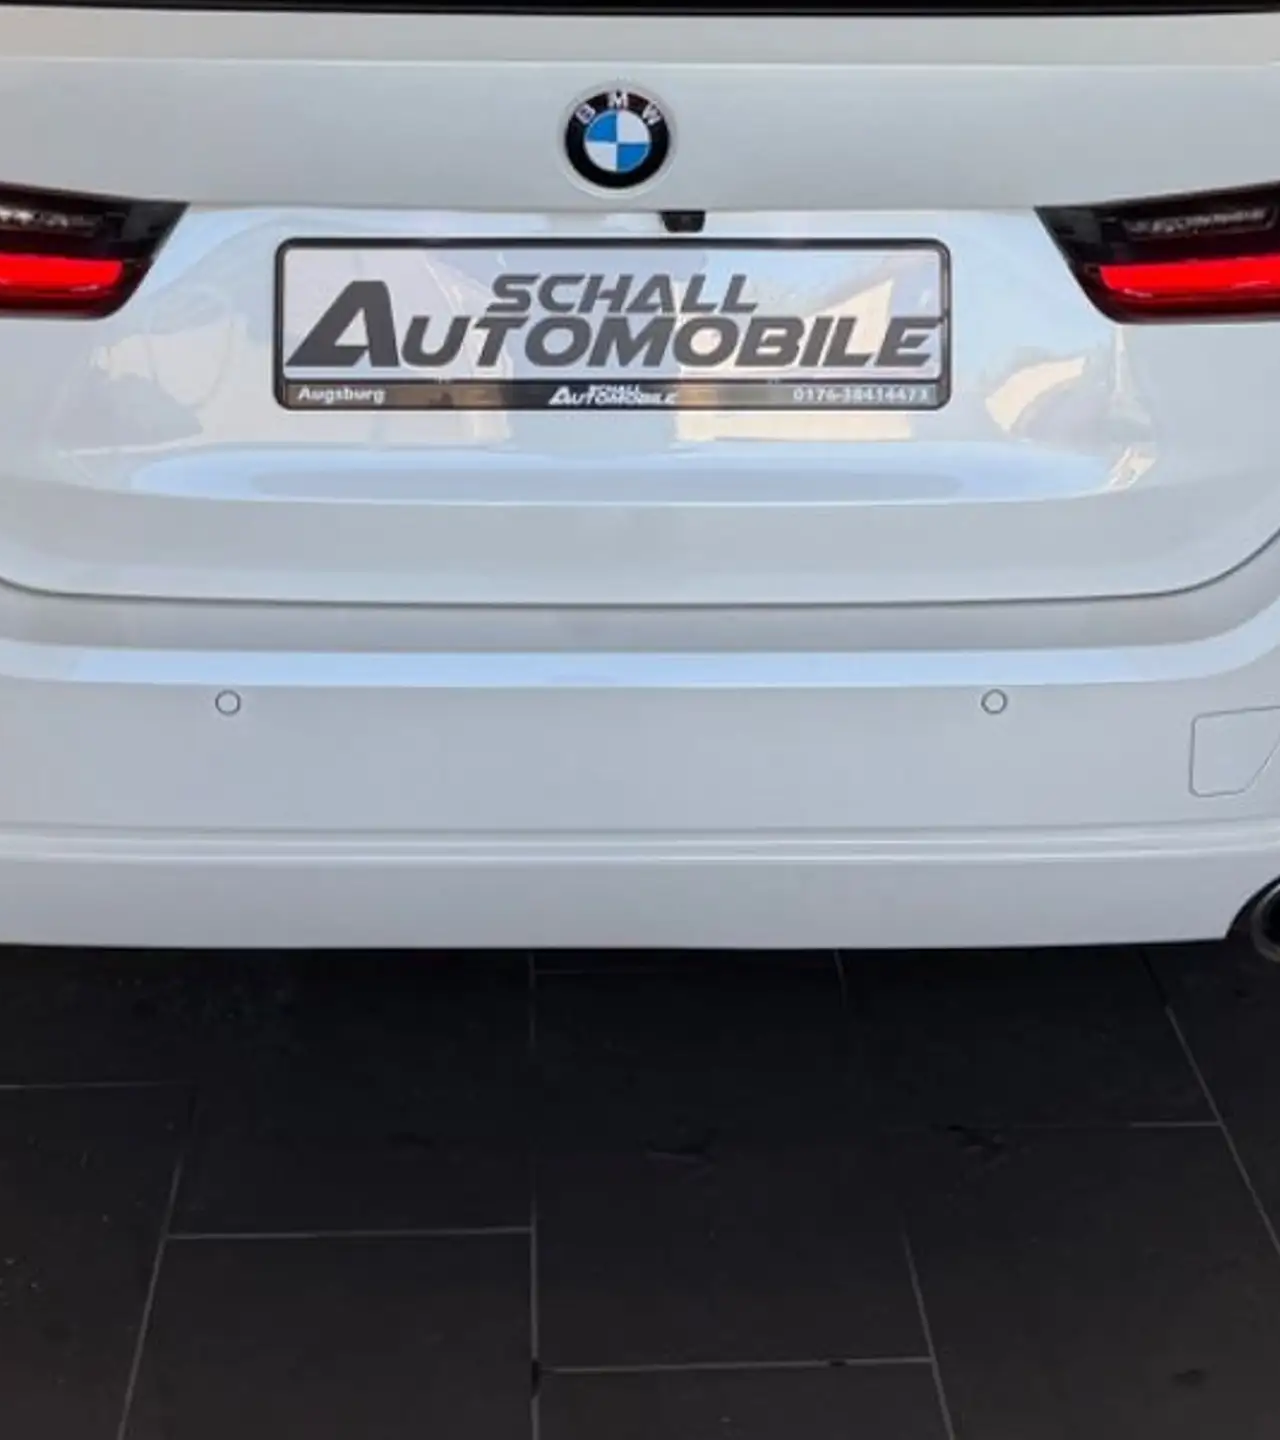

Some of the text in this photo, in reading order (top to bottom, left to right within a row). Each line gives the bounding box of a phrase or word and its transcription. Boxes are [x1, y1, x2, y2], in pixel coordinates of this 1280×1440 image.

[575, 90, 663, 126] BMW
[487, 273, 759, 314] SCHALL
[286, 280, 945, 369] AUTOMOBILE
[297, 385, 385, 404] Augsburg
